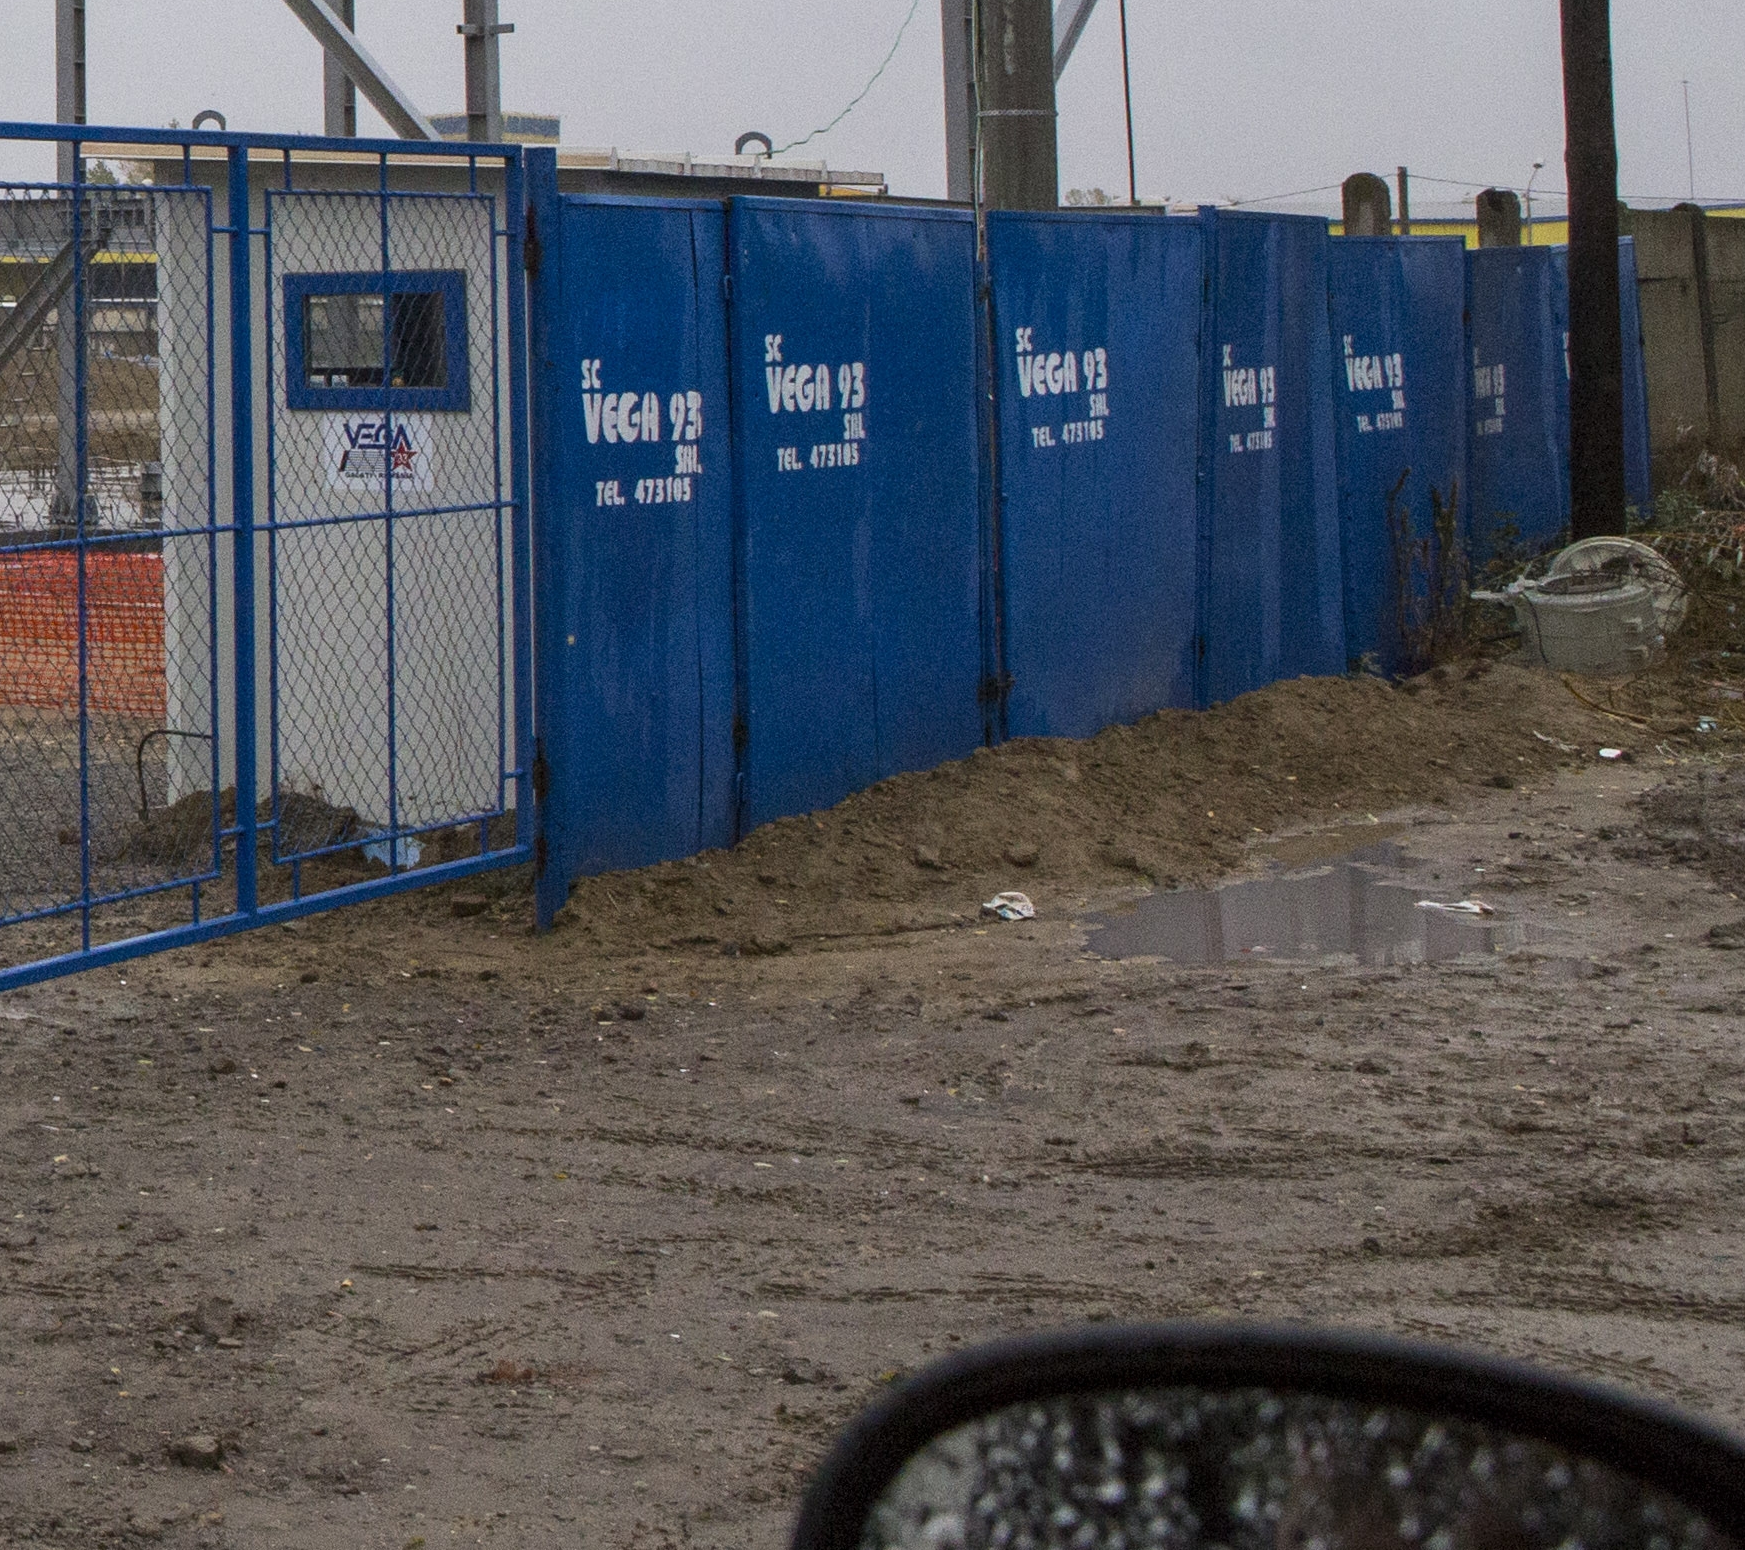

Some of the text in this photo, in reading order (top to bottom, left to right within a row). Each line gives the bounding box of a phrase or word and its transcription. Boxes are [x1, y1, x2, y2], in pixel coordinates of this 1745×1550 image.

[764, 334, 783, 362] SC
[1016, 327, 1033, 352] SC
[581, 359, 601, 389] SC
[765, 362, 865, 414] VEGA 93
[1017, 347, 1108, 398] VEGA 93
[1223, 366, 1276, 407] VEGA 93
[1345, 355, 1383, 392] VEGA
[582, 391, 703, 444] VEGA 93
[809, 442, 860, 469] 473105
[634, 476, 692, 504] 473105
